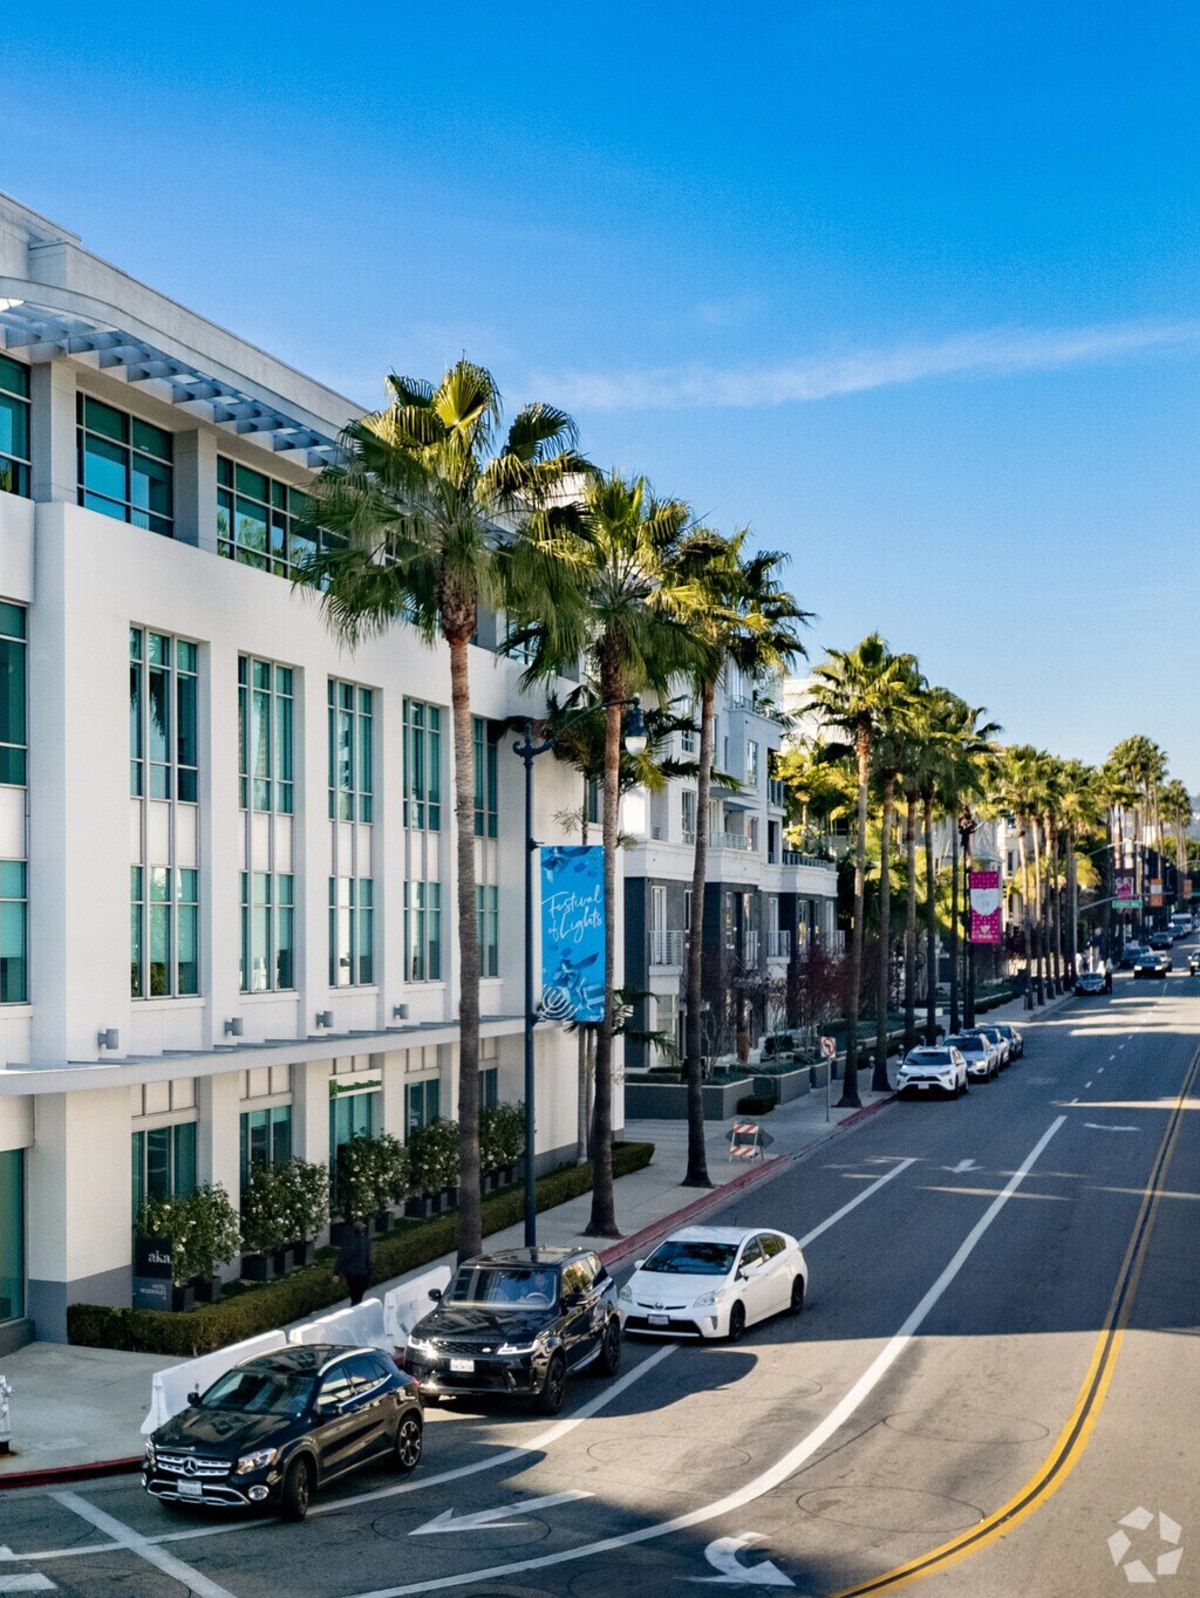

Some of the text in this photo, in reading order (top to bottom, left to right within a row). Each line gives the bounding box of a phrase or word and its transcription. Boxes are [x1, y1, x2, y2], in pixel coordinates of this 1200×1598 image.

[540, 884, 601, 919] Festival
[548, 906, 603, 944] of Lights
